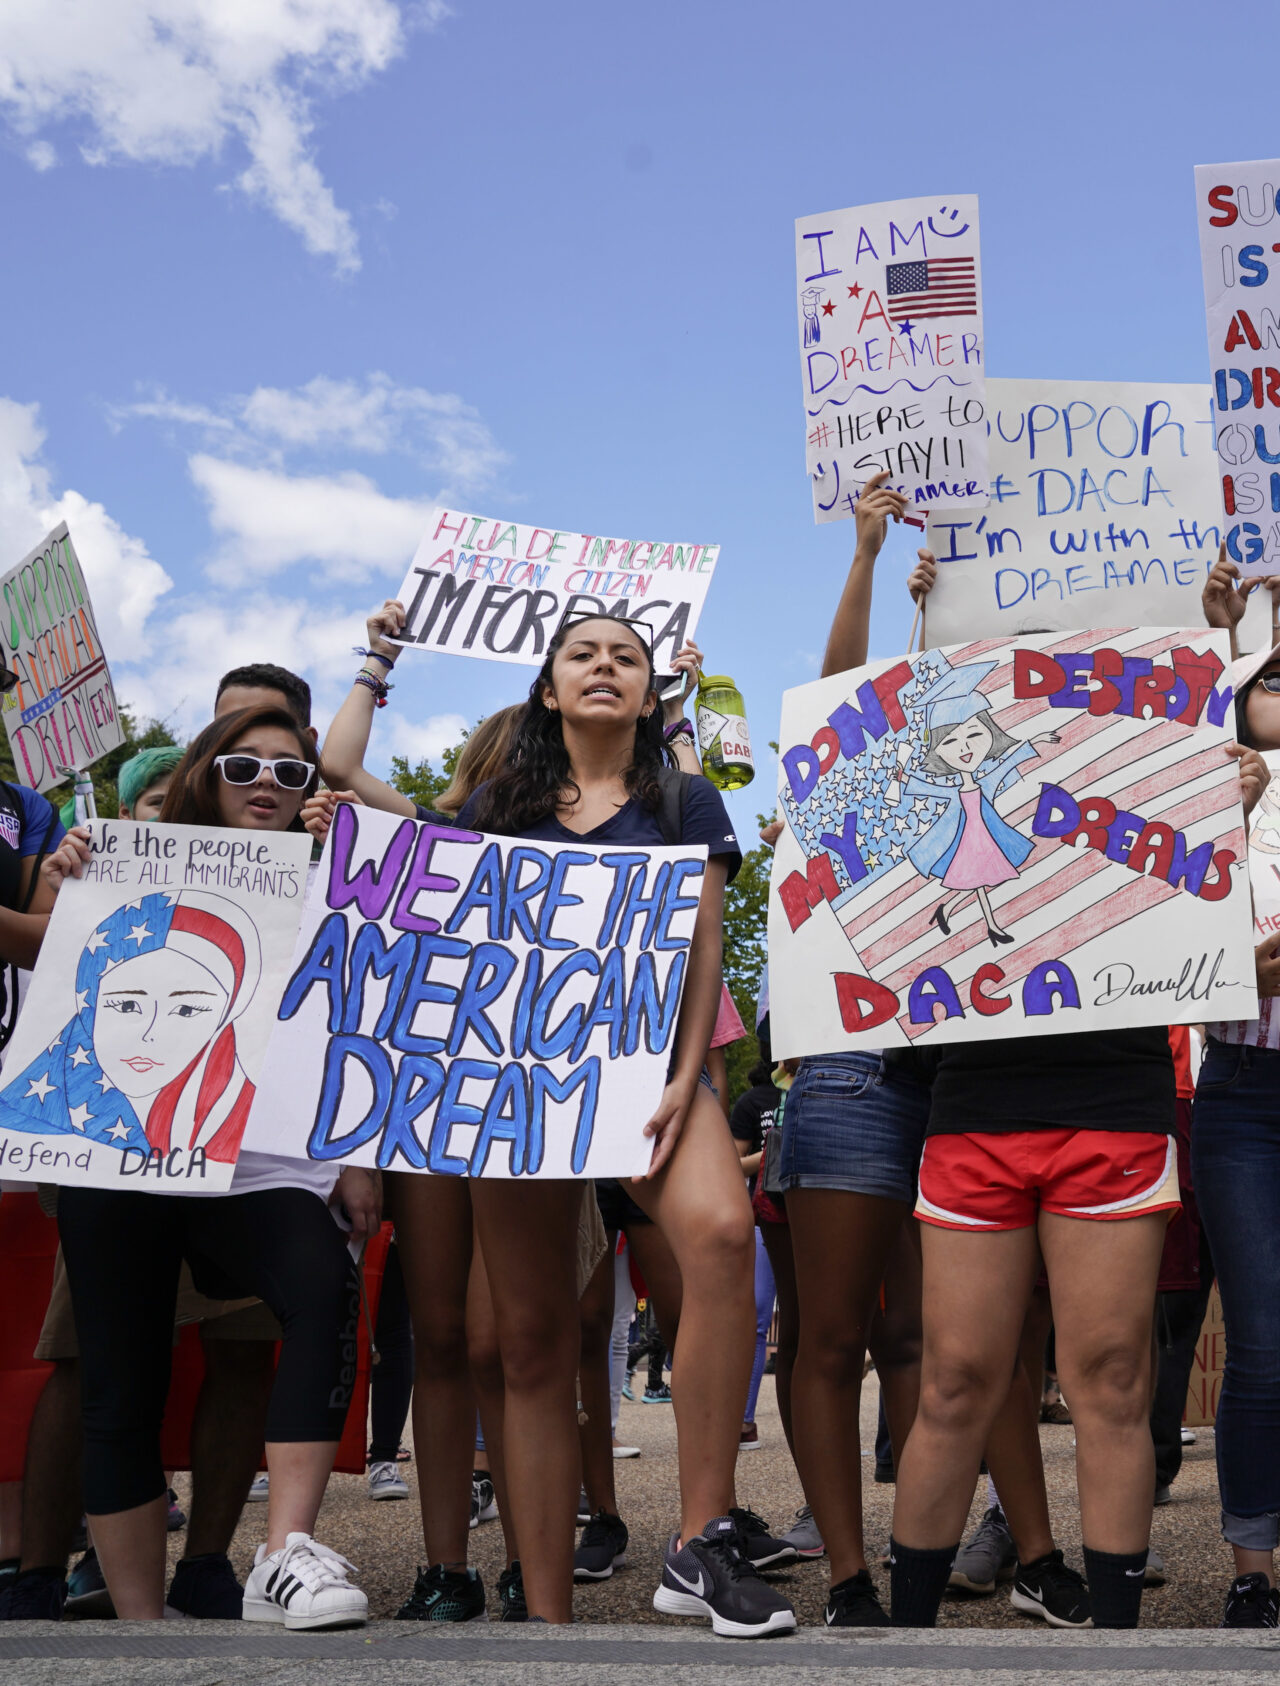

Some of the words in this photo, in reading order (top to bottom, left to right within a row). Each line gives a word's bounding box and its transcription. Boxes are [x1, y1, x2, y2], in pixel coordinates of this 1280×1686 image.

[803, 230, 842, 282] I
[855, 220, 928, 265] AM
[1222, 244, 1269, 288] IS
[857, 290, 893, 334] A
[807, 332, 981, 395] DREAMER
[808, 404, 925, 448] #HERE
[1223, 470, 1265, 516] IS
[433, 512, 518, 553] HIJA
[525, 529, 571, 564] DE
[933, 516, 1022, 563] I'm
[1050, 523, 1150, 555] with
[1168, 518, 1223, 550] th
[1, 532, 84, 650] SUPPORT
[429, 549, 550, 589] AMERICAN
[564, 568, 653, 598] CITIZEN
[995, 557, 1261, 610] DREAME
[462, 585, 559, 657] FOR
[12, 606, 103, 712] AMERICAN
[781, 660, 914, 803] DONT
[132, 827, 177, 859] the
[777, 811, 869, 934] MY
[1032, 782, 1240, 902] DREAMS
[85, 859, 130, 884] ARE
[138, 860, 174, 885] ALL
[184, 863, 300, 899] IMMIGRANTS
[325, 802, 484, 934] WE
[443, 842, 597, 951] ARE
[597, 852, 706, 952] THE
[277, 911, 688, 1064] AMERICAN
[829, 959, 1082, 1034] DACA
[306, 1033, 602, 1178] DREAM
[119, 1146, 207, 1178] DACA
[328, 1265, 361, 1409] Reebok
